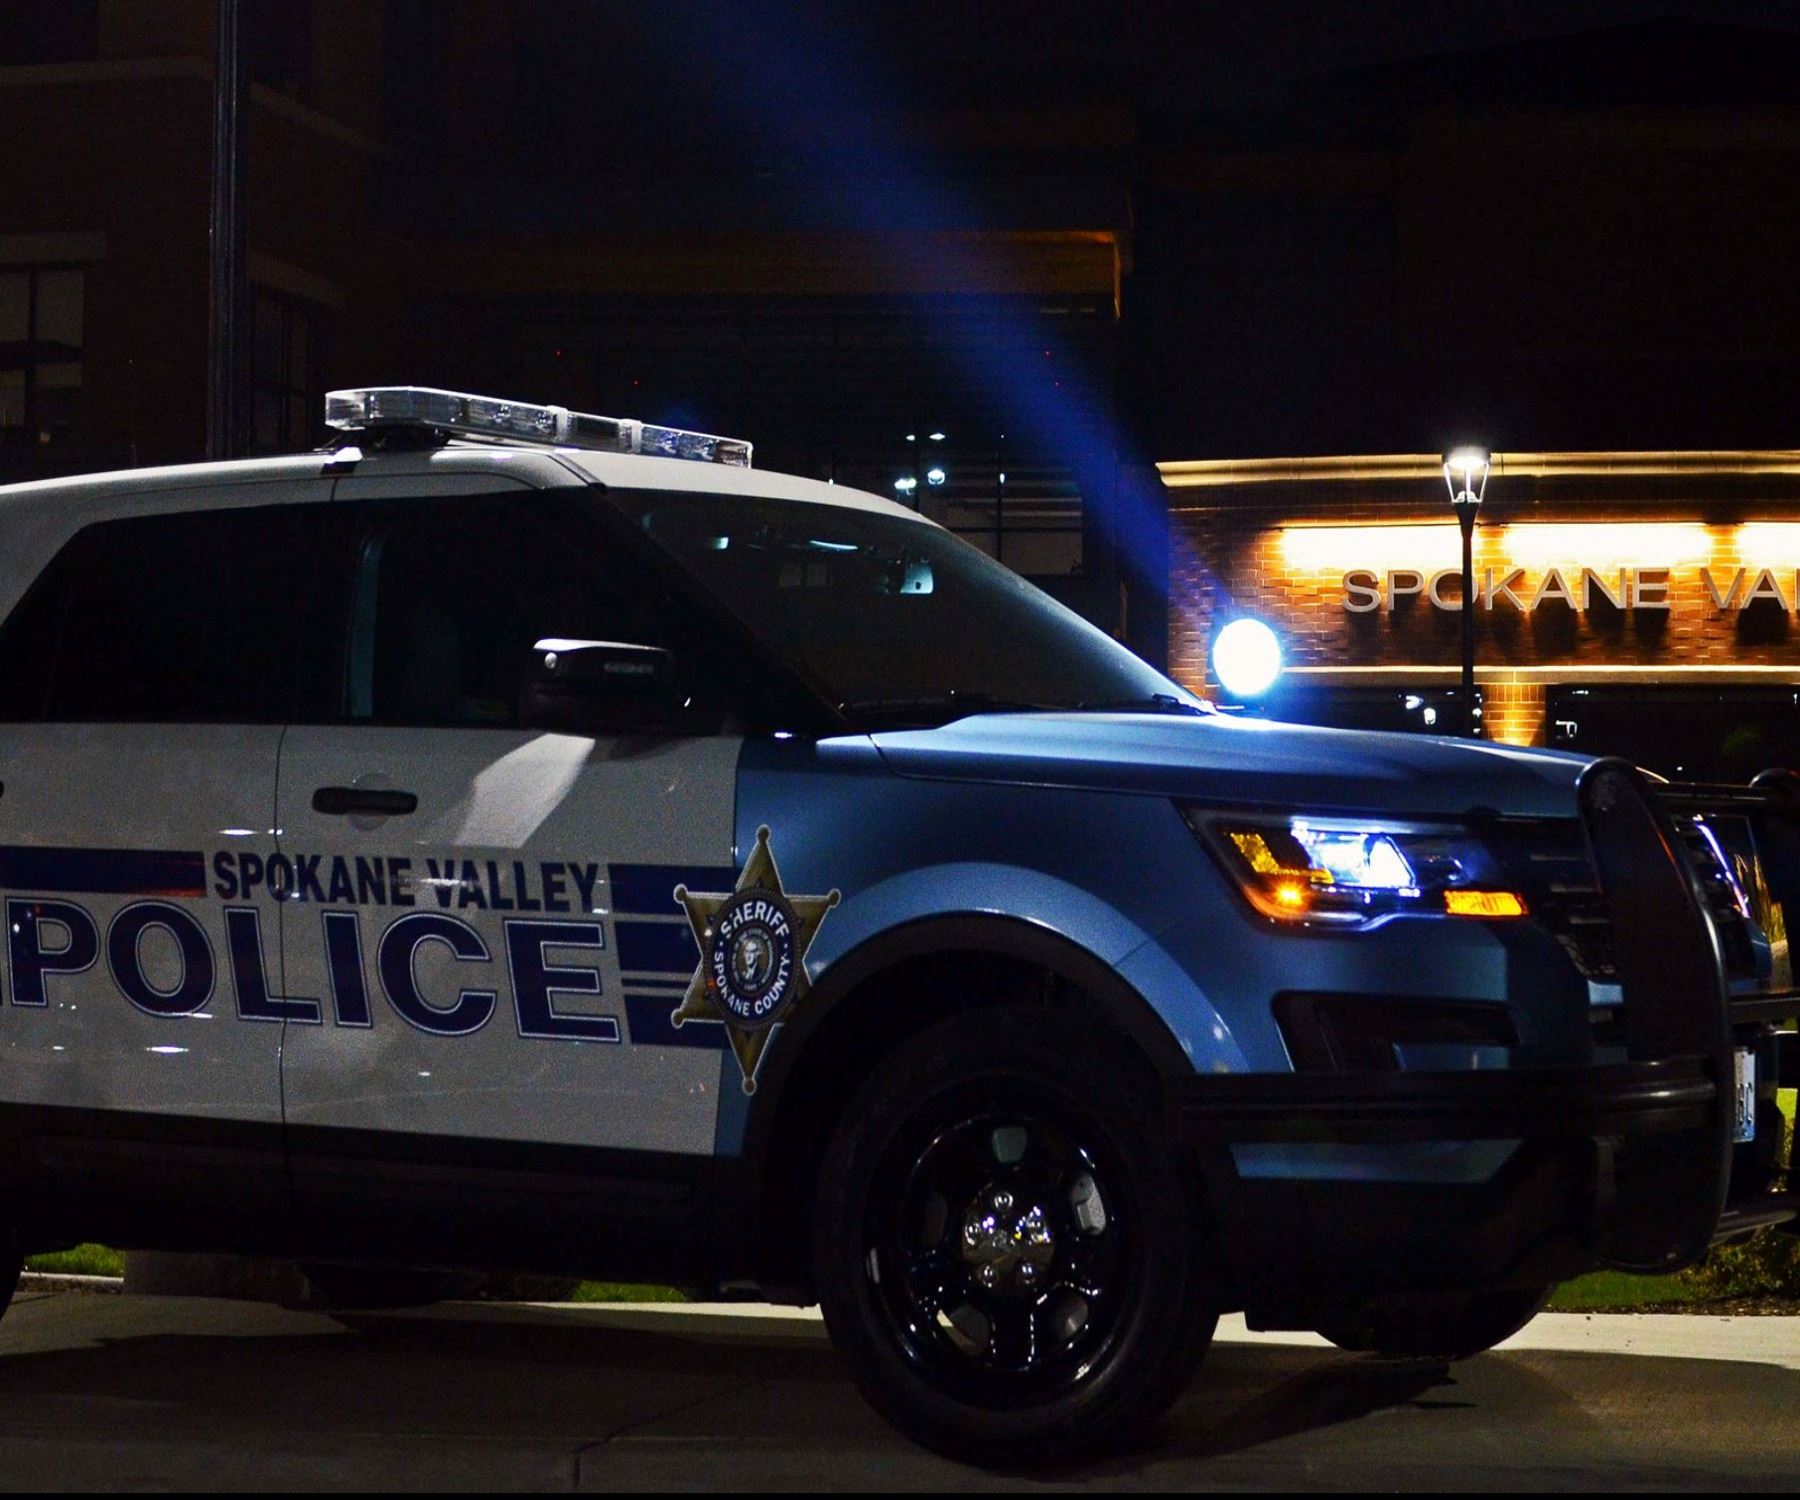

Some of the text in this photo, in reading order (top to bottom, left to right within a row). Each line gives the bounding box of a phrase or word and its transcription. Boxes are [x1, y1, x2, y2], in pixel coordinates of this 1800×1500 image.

[1342, 567, 1800, 613] SPOKANE VA
[213, 851, 599, 912] SPOKANE VALLEY
[720, 900, 790, 939] SHERIFF
[5, 896, 621, 1043] POLICE
[714, 951, 751, 1016] SPOKANE
[754, 953, 790, 1015] COUNTY
